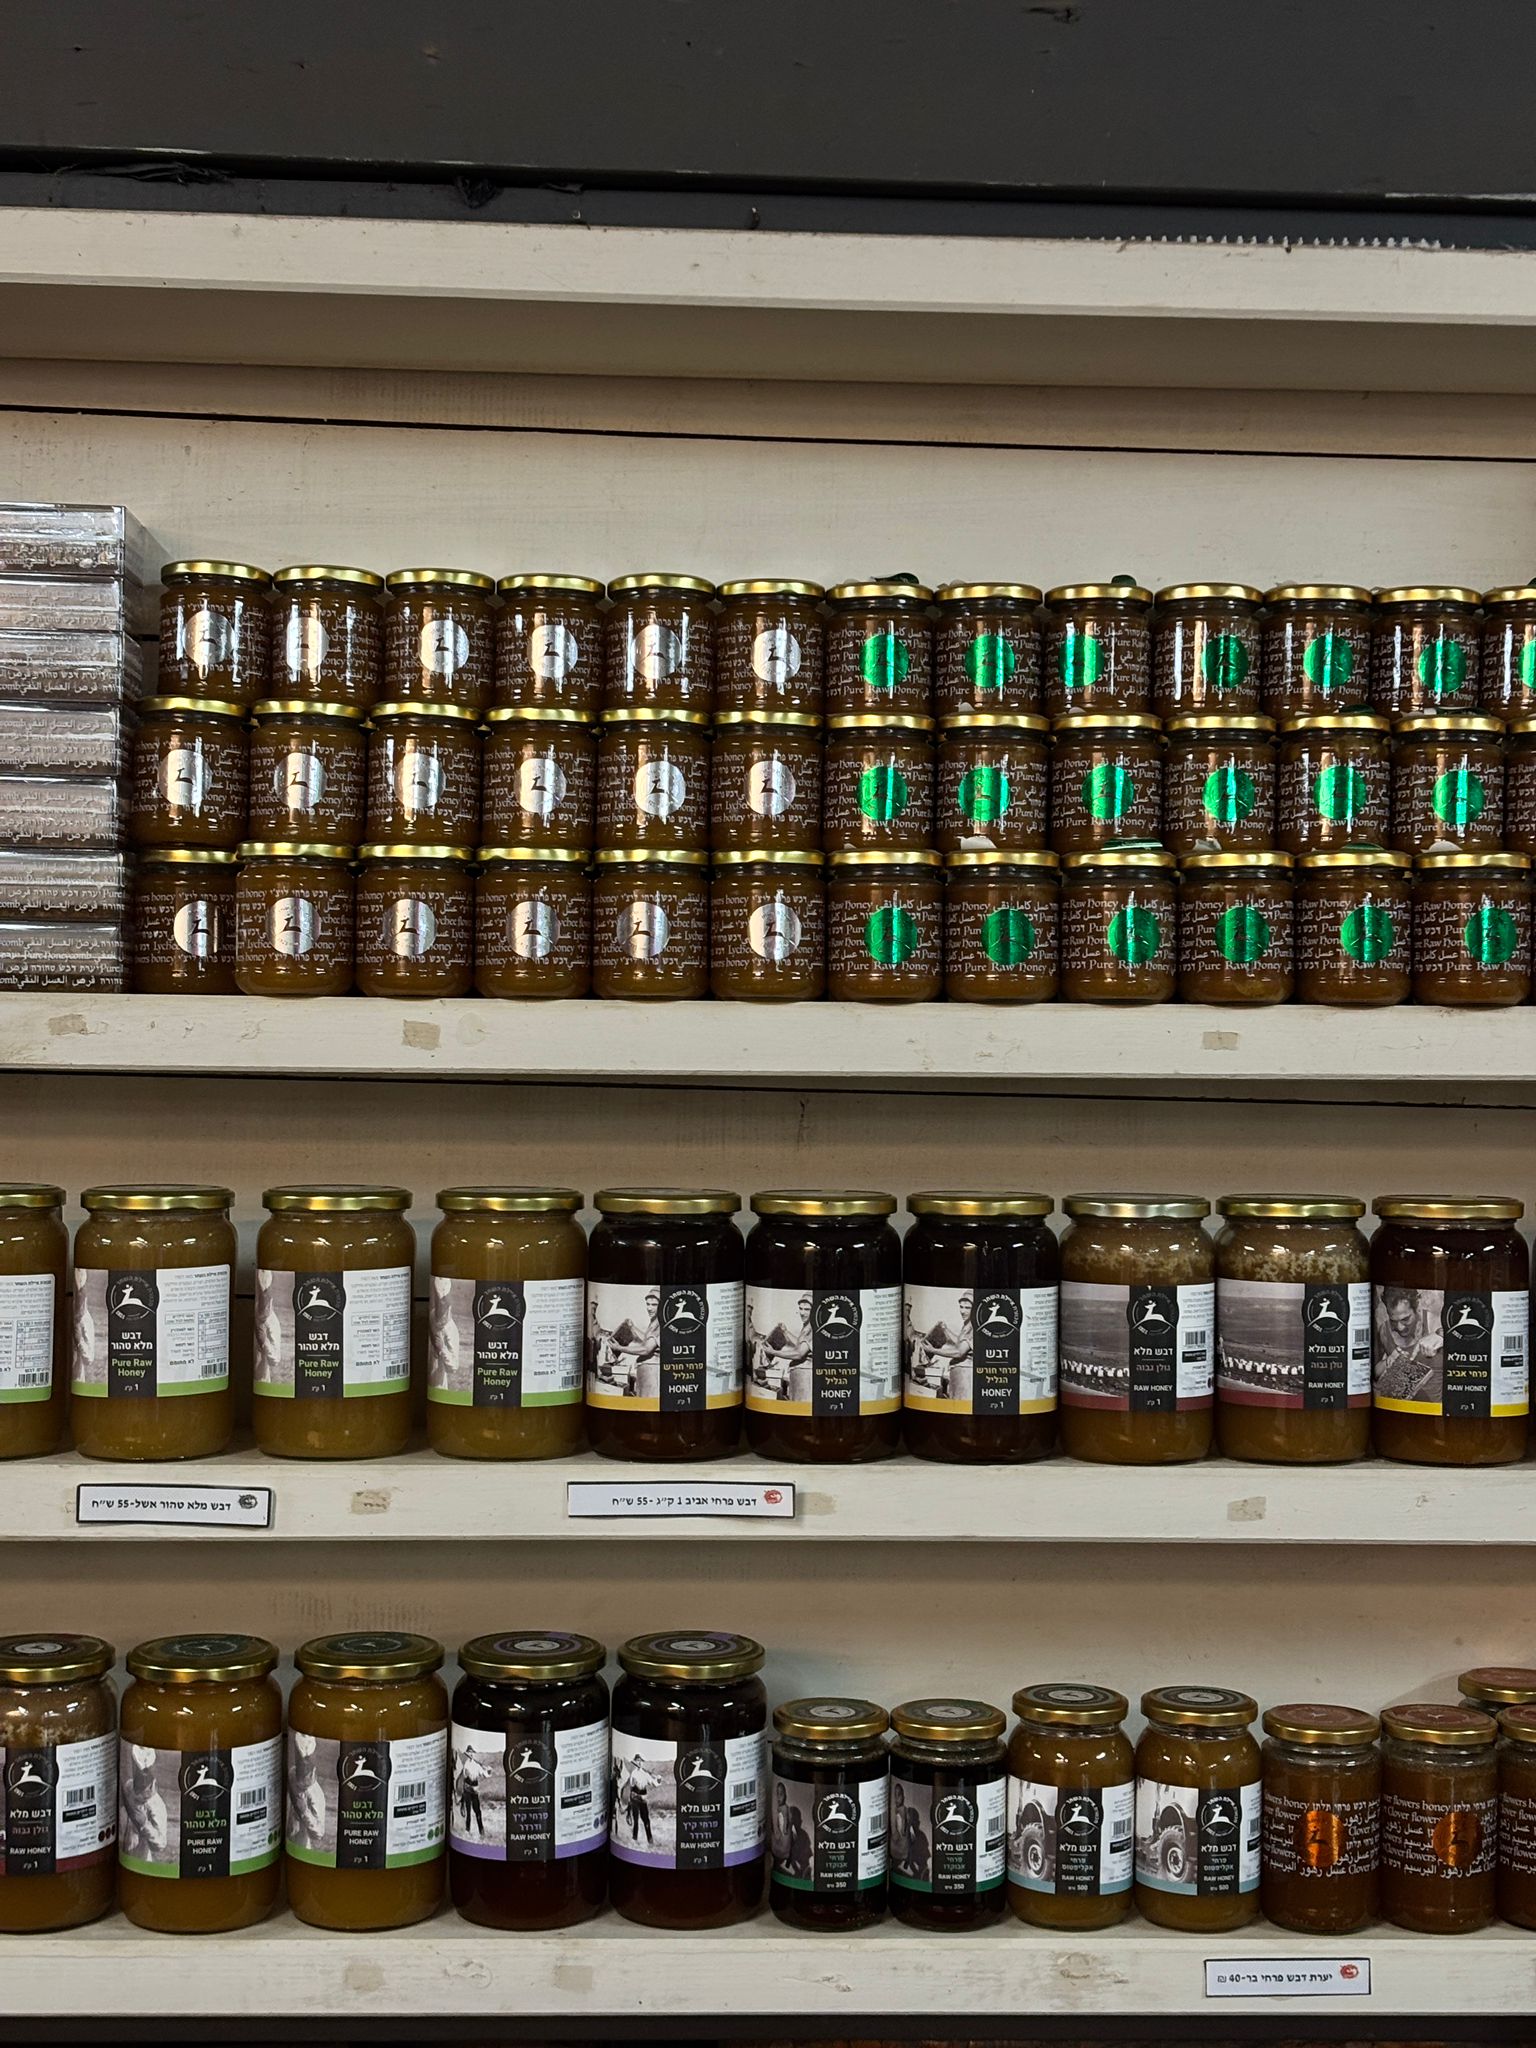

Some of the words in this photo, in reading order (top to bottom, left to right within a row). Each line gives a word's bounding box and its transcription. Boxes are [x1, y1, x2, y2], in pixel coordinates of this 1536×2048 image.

[1066, 817, 1087, 826] Pure
[847, 963, 869, 971] Pure
[873, 961, 896, 970] Raw
[965, 963, 986, 972] Pure
[992, 963, 1015, 971] Raw
[1198, 962, 1221, 971] Pure
[1225, 961, 1249, 970] Raw
[122, 1332, 141, 1340] דבש
[309, 1332, 328, 1340] דבש
[134, 1341, 152, 1349] מלא
[488, 1341, 508, 1349] דבש
[673, 1345, 696, 1354] דבש
[986, 1349, 1009, 1358] דבש
[477, 1351, 497, 1359] טהור
[500, 1351, 518, 1359] מלא
[825, 1350, 848, 1360] דבש
[1469, 1353, 1487, 1361] דבש
[112, 1359, 131, 1367] Pure
[134, 1359, 152, 1367] Raw
[1329, 1361, 1342, 1369] גולן
[118, 1369, 145, 1377] Honey
[305, 1369, 332, 1378] Honey
[484, 1378, 511, 1386] Honey
[825, 1377, 848, 1385] הגליל
[669, 1385, 699, 1393] HONEY
[821, 1390, 851, 1398] HONEY
[685, 1497, 708, 1505] אביב
[711, 1497, 733, 1505] פרחי
[737, 1498, 757, 1506] דבש
[187, 1502, 207, 1510] מלא
[211, 1503, 231, 1511] דבש
[510, 1796, 529, 1804] מלא
[531, 1796, 550, 1804] דבש
[353, 1801, 373, 1809] דבש
[681, 1805, 699, 1813] מלא
[702, 1804, 721, 1812] דבש
[10, 1809, 29, 1817] מלא
[32, 1809, 52, 1817] דבש
[196, 1808, 216, 1817] דבש
[364, 1810, 383, 1818] מלא
[184, 1820, 205, 1828] טהור
[208, 1819, 226, 1827] מלא
[528, 1833, 551, 1841] HONEY
[698, 1841, 720, 1849] HONEY
[1060, 1844, 1077, 1852] מלא
[27, 1846, 51, 1854] HONEY
[1261, 1974, 1283, 1982] פרחי
